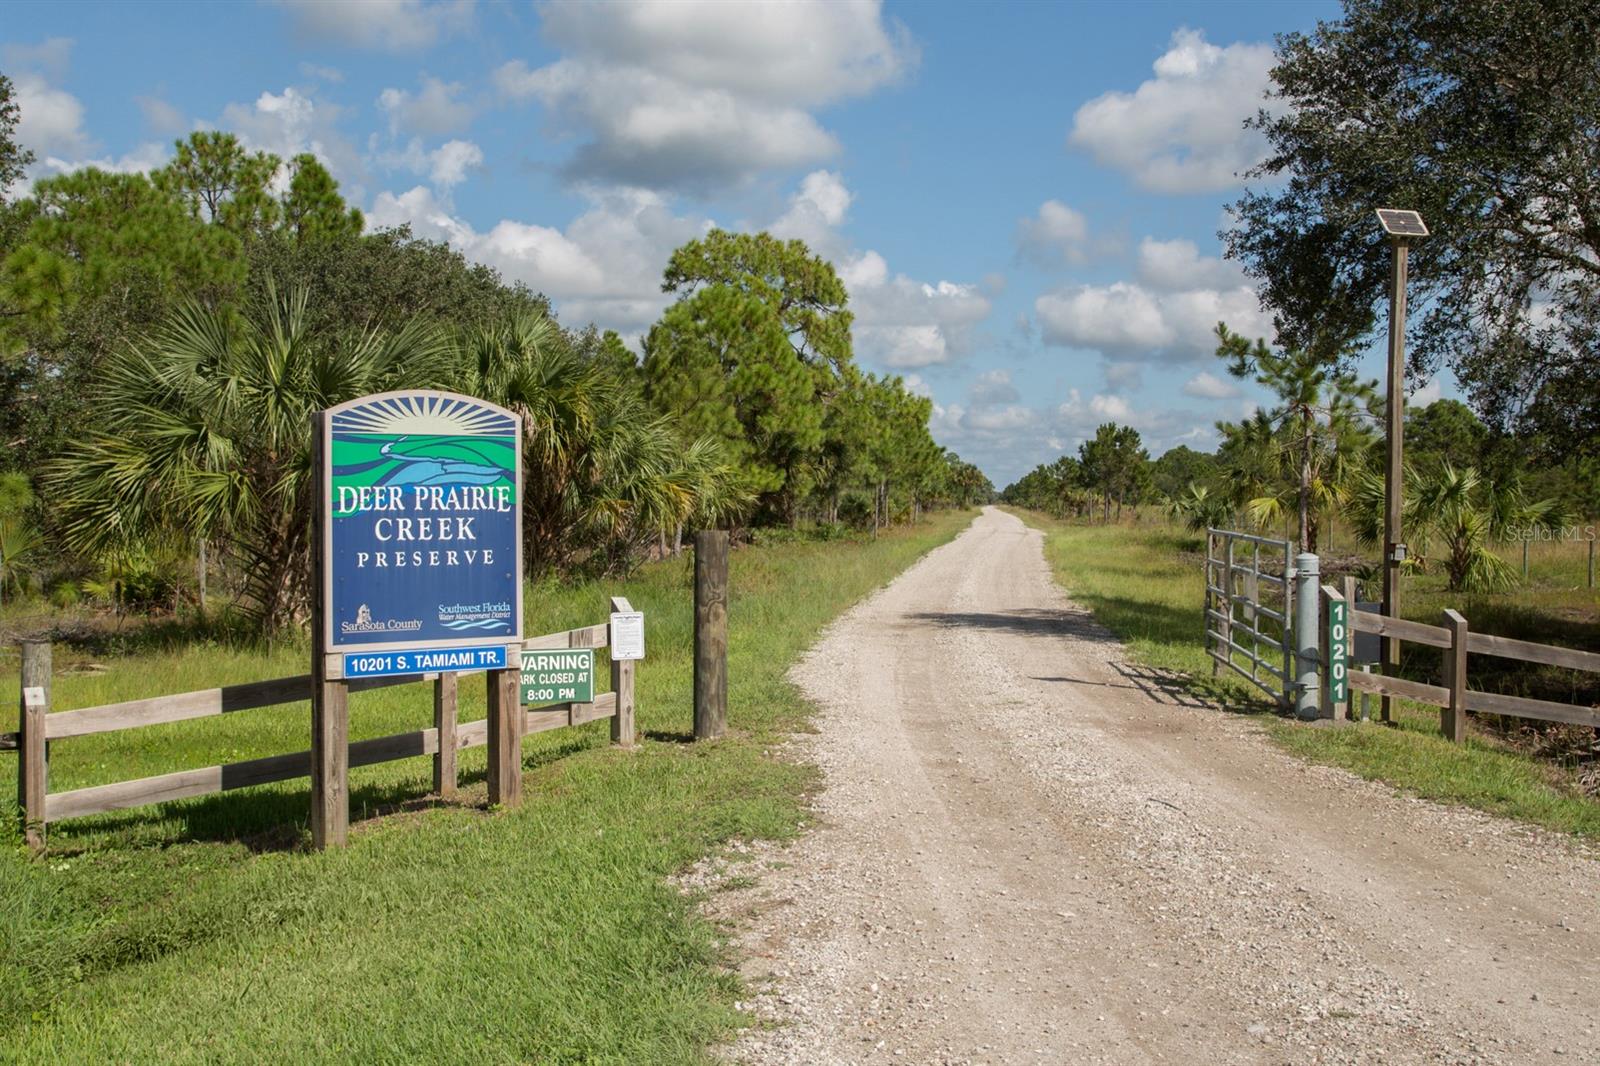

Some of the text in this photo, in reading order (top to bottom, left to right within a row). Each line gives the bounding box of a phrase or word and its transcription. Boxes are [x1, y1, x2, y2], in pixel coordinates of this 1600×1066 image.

[337, 486, 511, 513] DEER PRAIRIE
[374, 517, 476, 541] CREEK
[357, 549, 494, 568] PRESERVE
[438, 602, 511, 614] Southwest Florida
[438, 613, 455, 621] Water
[455, 612, 491, 621] Management
[341, 619, 423, 632] Sarasota County
[1332, 604, 1345, 699] 10201
[351, 651, 500, 672] 10201 S. TAMIAMI TR.
[538, 672, 575, 684] CLOSED
[578, 672, 588, 682] AT
[527, 688, 575, 701] 8:00 PM
